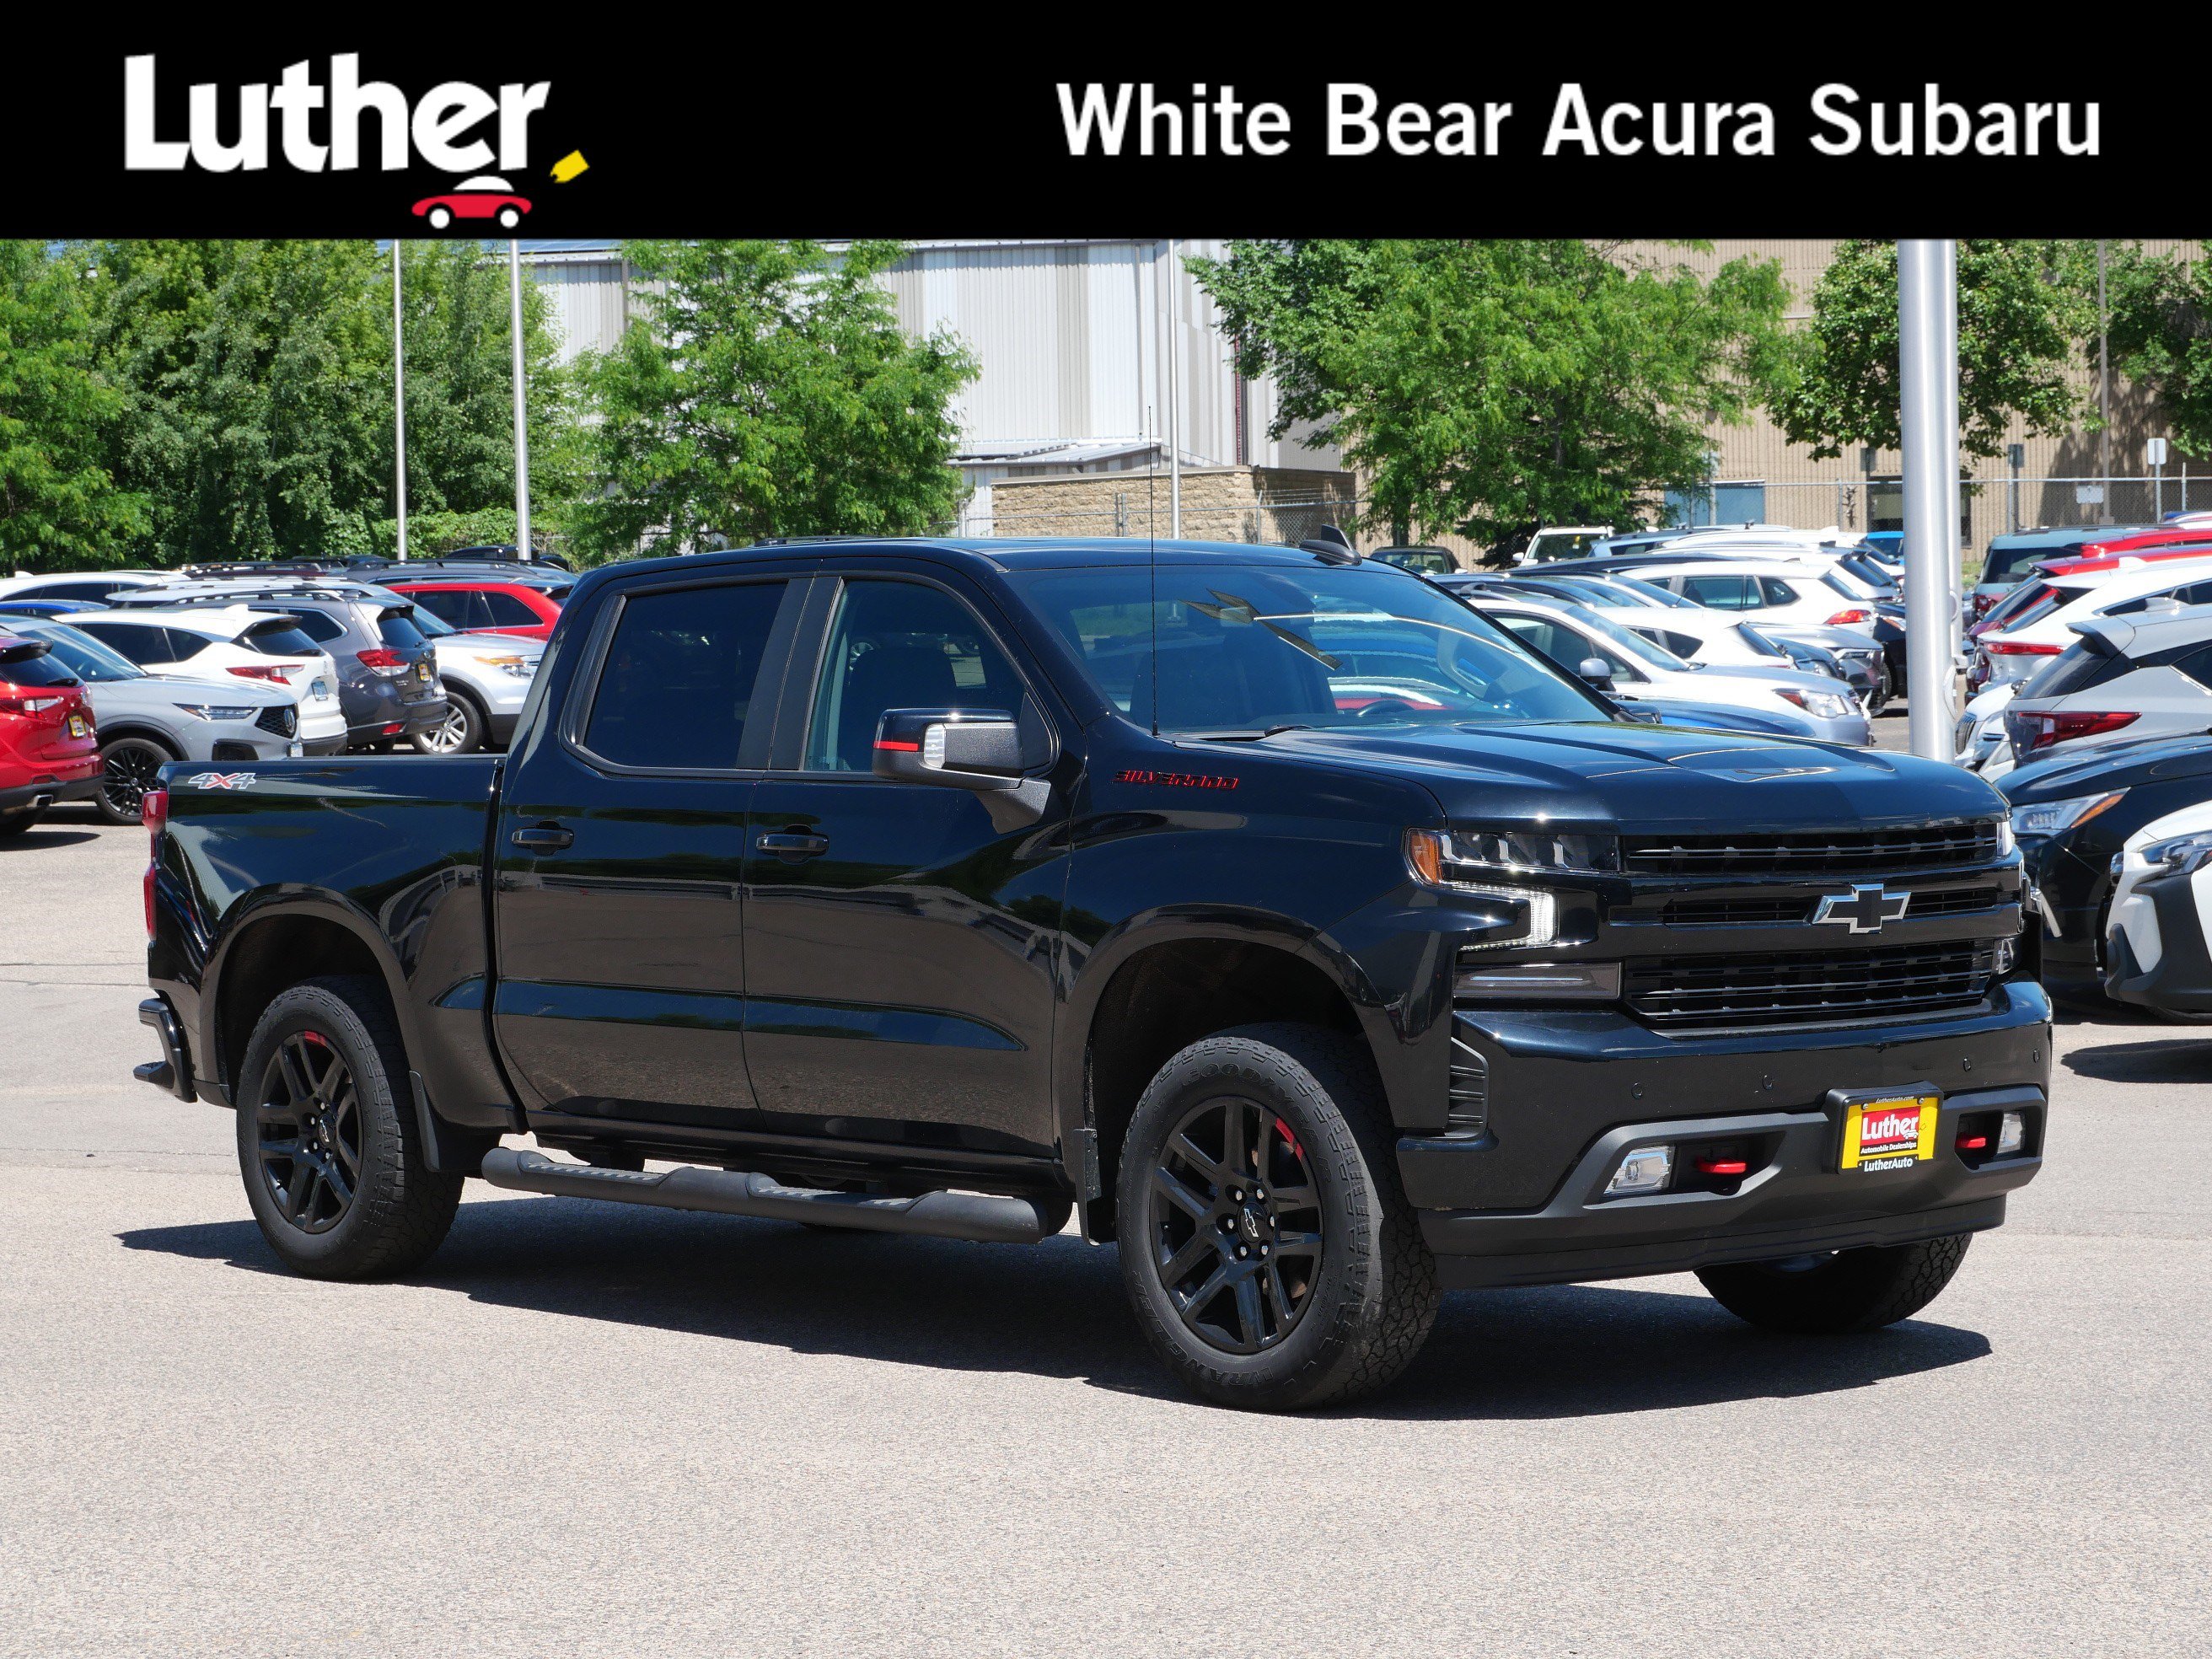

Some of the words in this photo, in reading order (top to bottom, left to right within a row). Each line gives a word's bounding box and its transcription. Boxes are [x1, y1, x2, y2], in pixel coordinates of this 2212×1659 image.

[1113, 770, 1240, 790] SILVERADO
[1861, 1114, 1919, 1141] Luther
[1861, 1144, 1889, 1154] Automobile
[1890, 1141, 1917, 1150] Dealerships
[1864, 1157, 1914, 1173] LutherAuto
